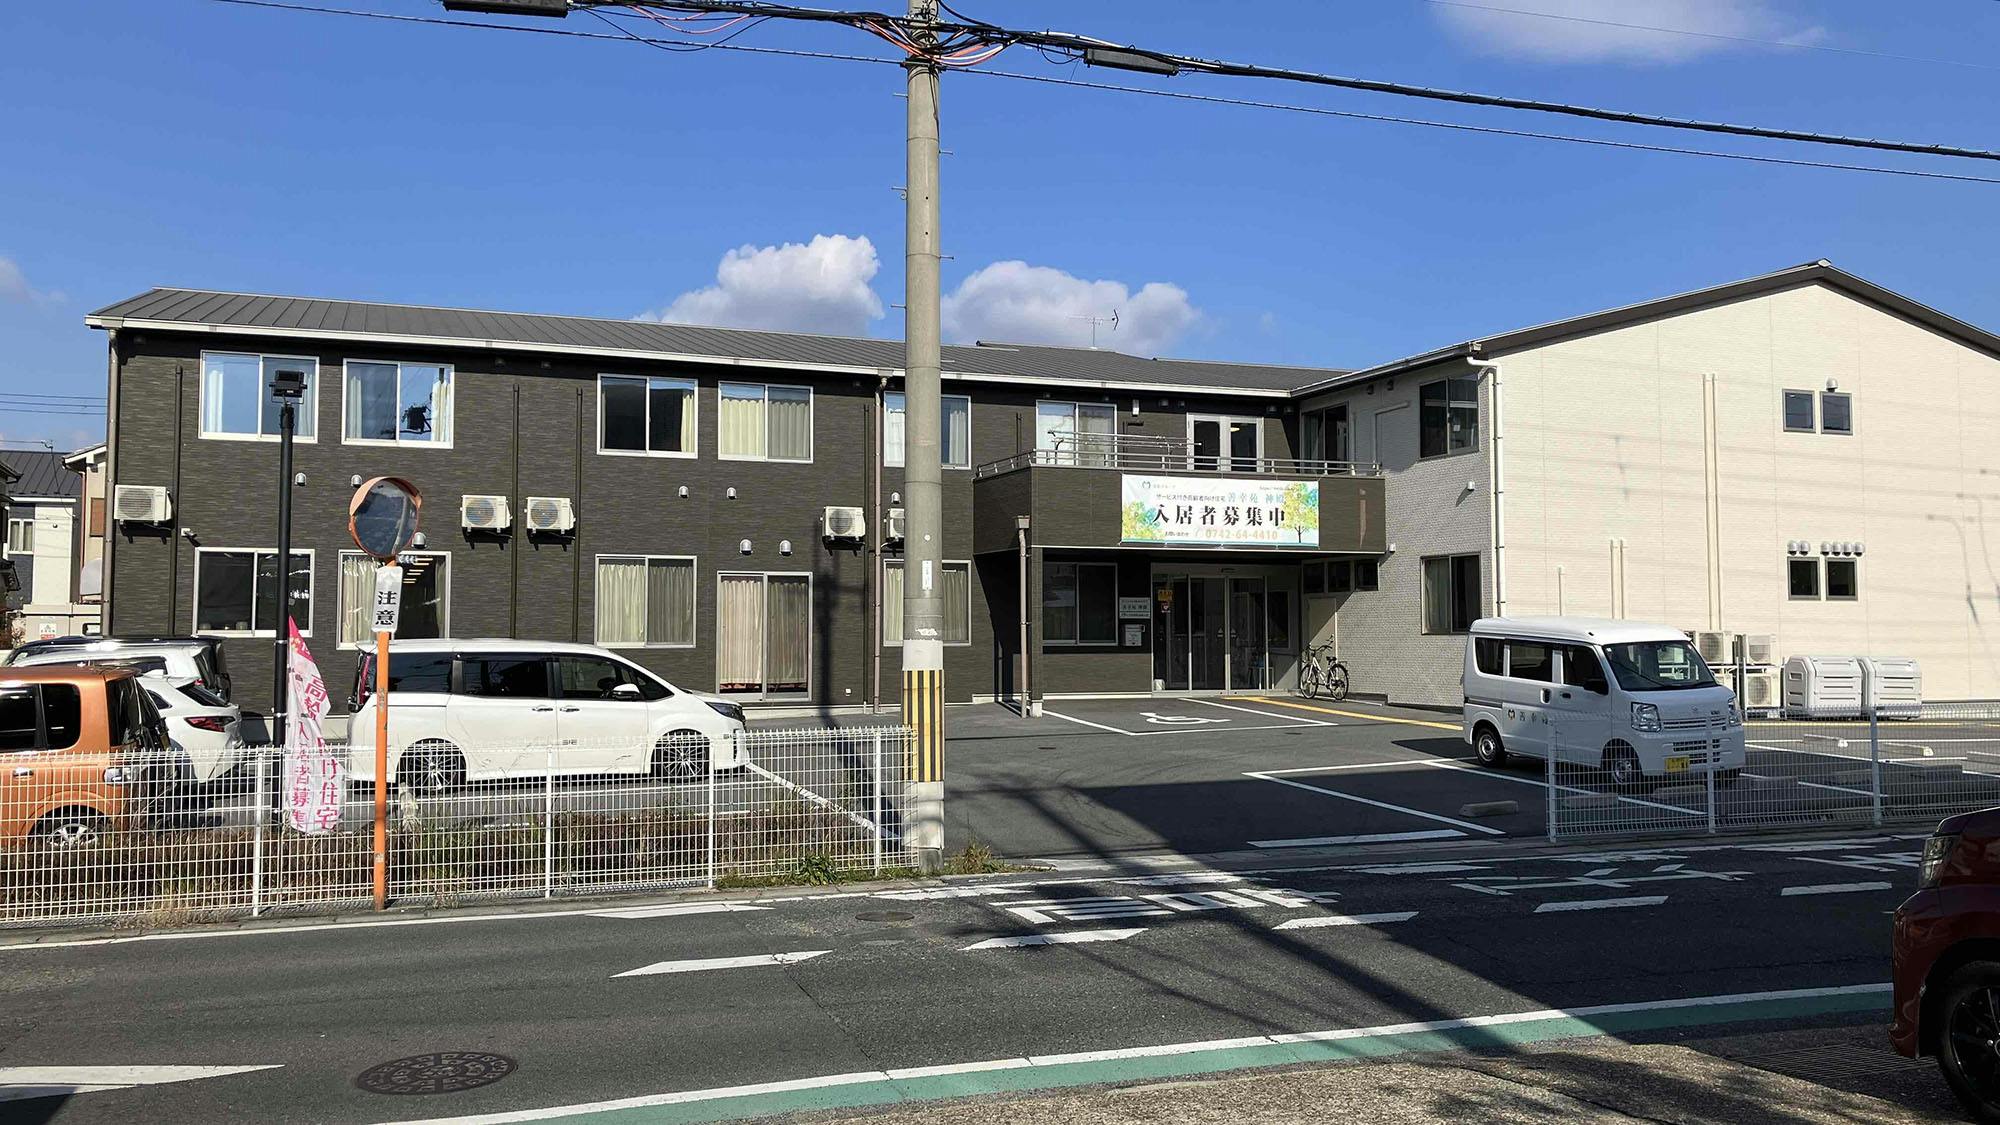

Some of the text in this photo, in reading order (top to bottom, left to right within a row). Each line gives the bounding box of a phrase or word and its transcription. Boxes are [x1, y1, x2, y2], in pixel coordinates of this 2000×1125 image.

[1153, 504, 1285, 527] 入居者募集中
[375, 590, 397, 626] 注意
